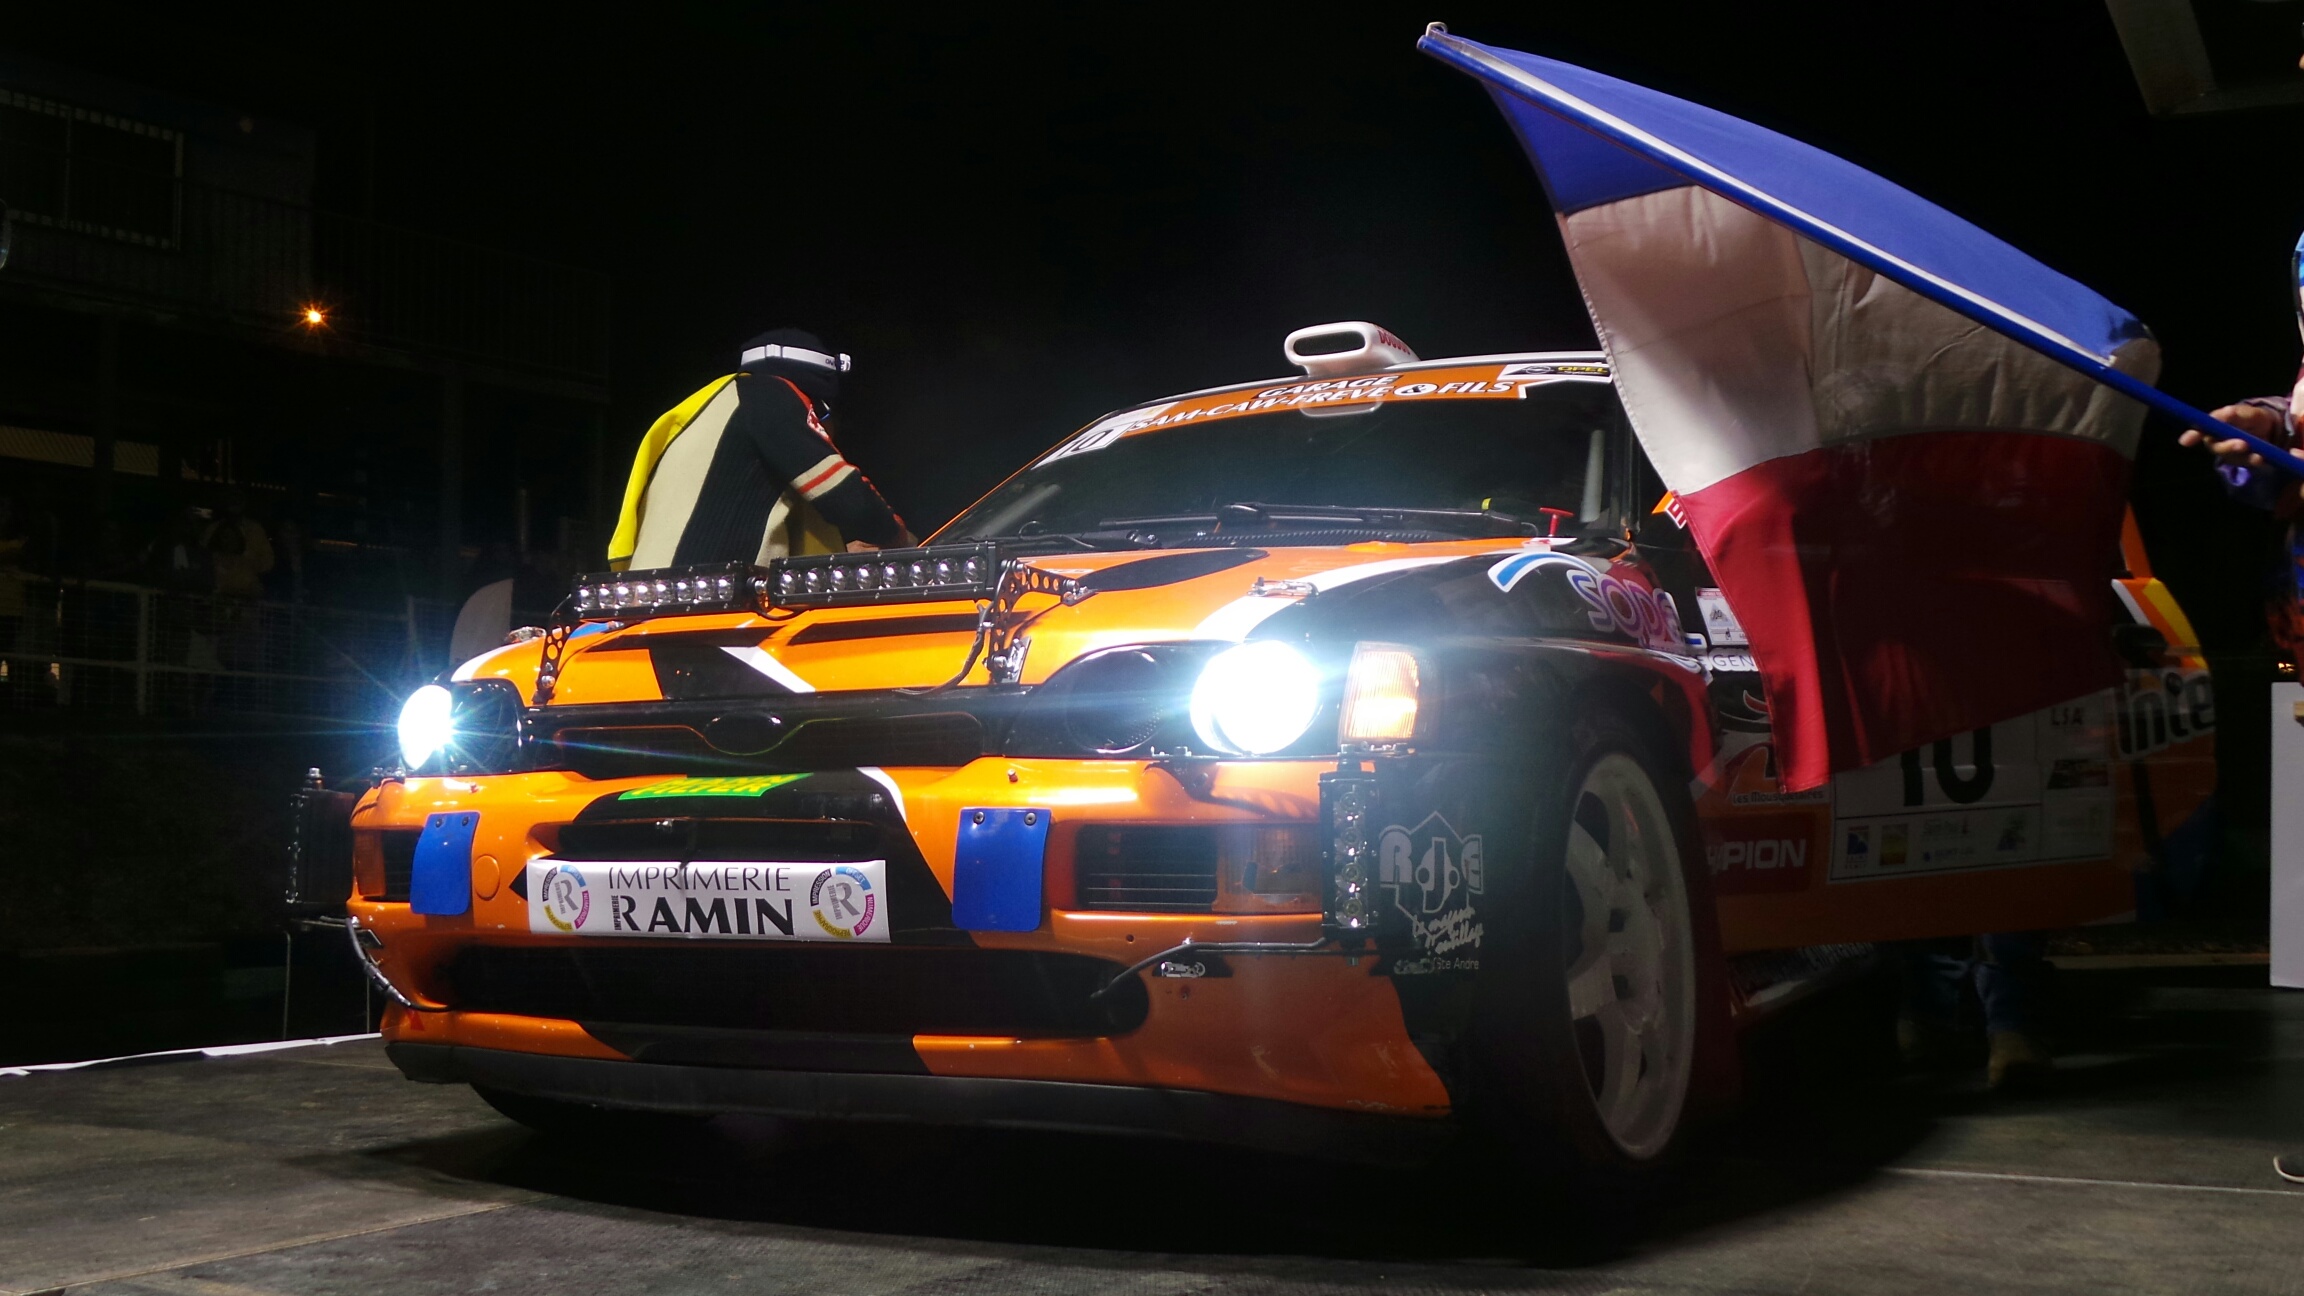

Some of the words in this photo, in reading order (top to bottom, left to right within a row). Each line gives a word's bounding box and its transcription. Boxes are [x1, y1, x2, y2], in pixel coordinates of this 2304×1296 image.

[1557, 365, 1609, 373] OPEL
[1256, 375, 1402, 399] GARAGE
[1437, 381, 1517, 394] FILS
[608, 866, 791, 892] IMPRIMERIE
[812, 870, 831, 904] IMPRESSION
[560, 879, 579, 911] R
[836, 882, 860, 916] R
[610, 895, 622, 931] IMPRIMERIE
[619, 895, 795, 936] RAMIN
